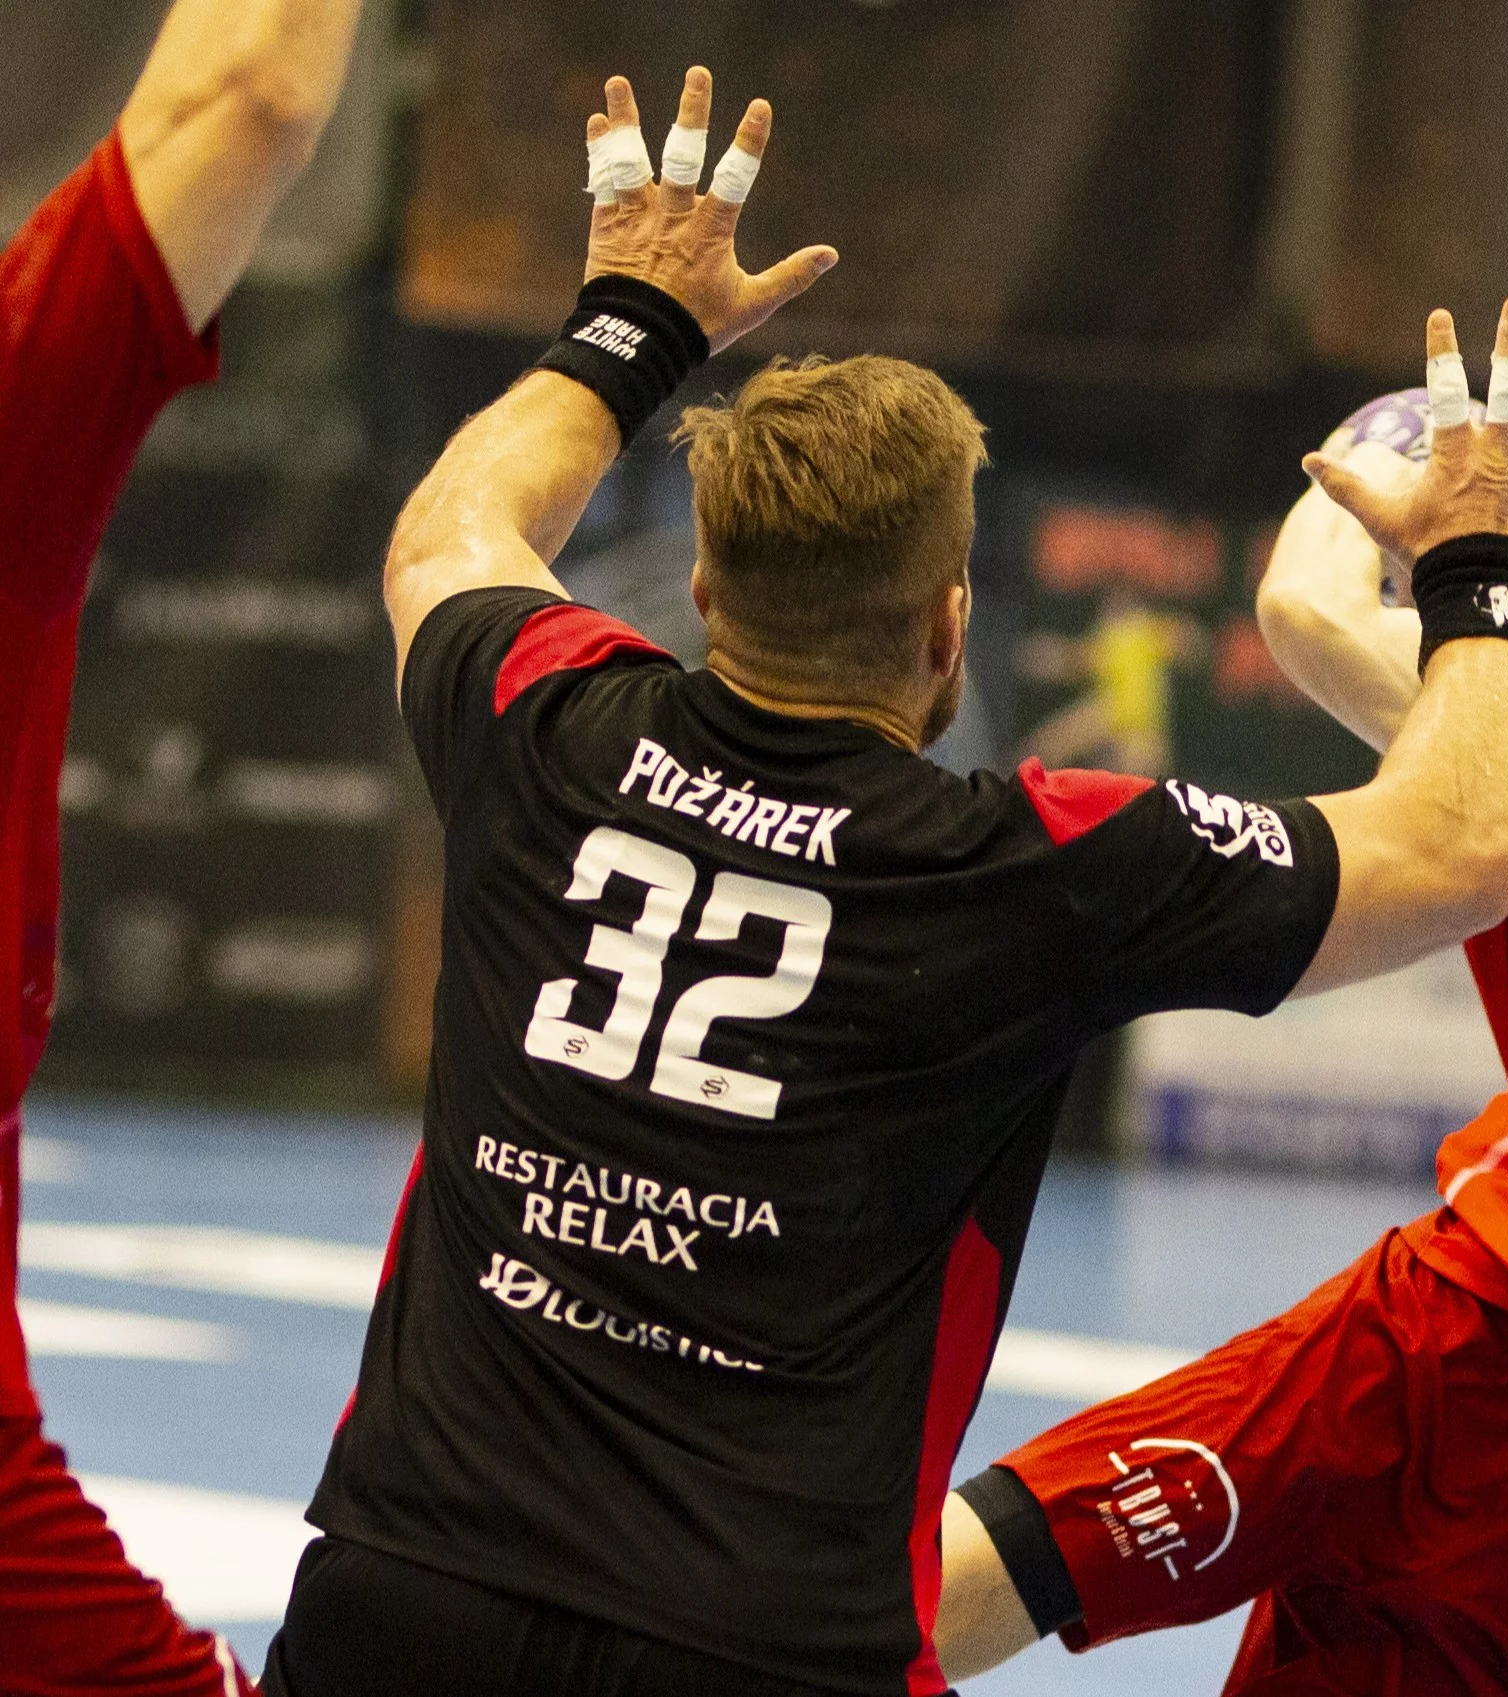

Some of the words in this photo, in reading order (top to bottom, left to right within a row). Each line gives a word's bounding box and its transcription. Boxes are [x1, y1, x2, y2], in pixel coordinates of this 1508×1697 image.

[572, 325, 638, 361] WHITE
[618, 737, 851, 866] POŽÁREK
[524, 826, 833, 1120] 32
[475, 1135, 781, 1239] RESTAURACJA
[522, 1192, 699, 1271] RELAX
